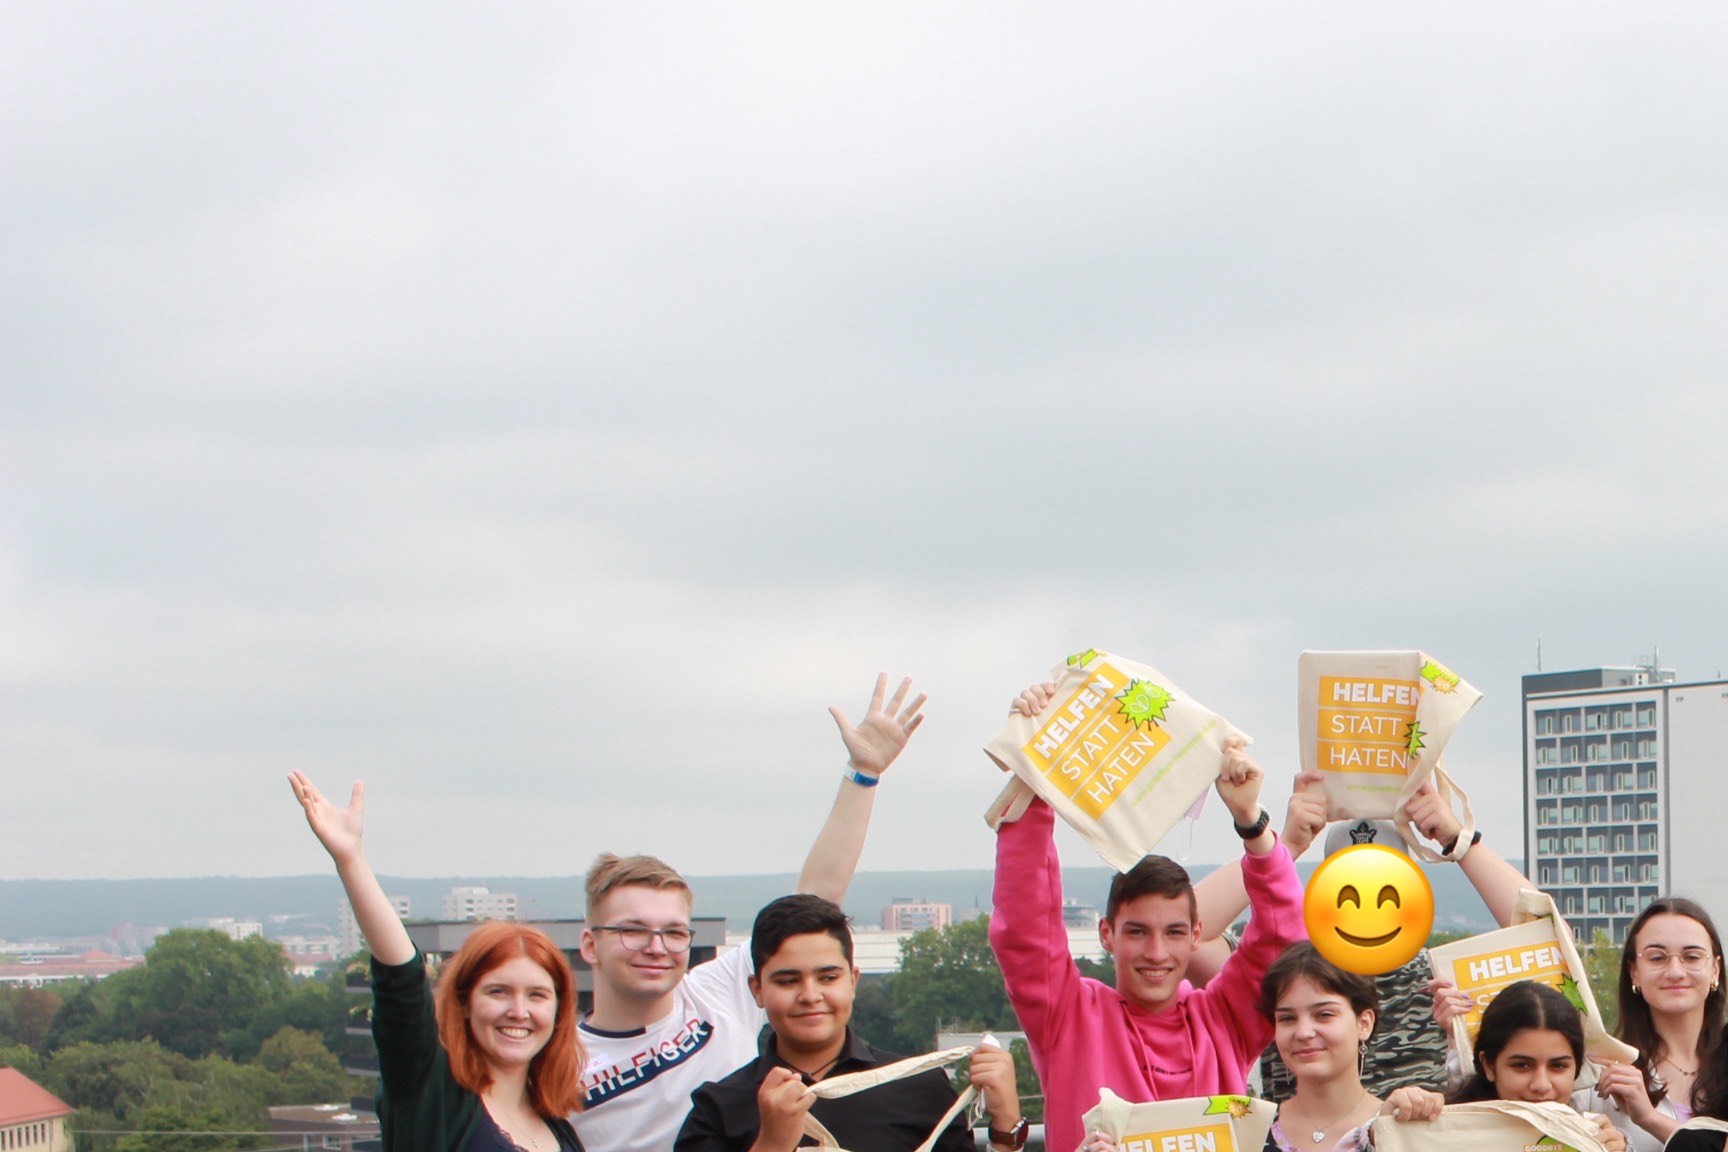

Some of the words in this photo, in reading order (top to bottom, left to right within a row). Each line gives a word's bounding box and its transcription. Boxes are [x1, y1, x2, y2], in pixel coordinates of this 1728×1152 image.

[1033, 673, 1115, 759] HELFEN
[1061, 714, 1120, 781] STATT
[1331, 714, 1402, 736] STATT
[1086, 731, 1155, 804] HATEN
[1330, 747, 1406, 769] HATEN
[580, 1018, 708, 1101] HILFIGER
[1525, 1144, 1563, 1152] GOODBYE
